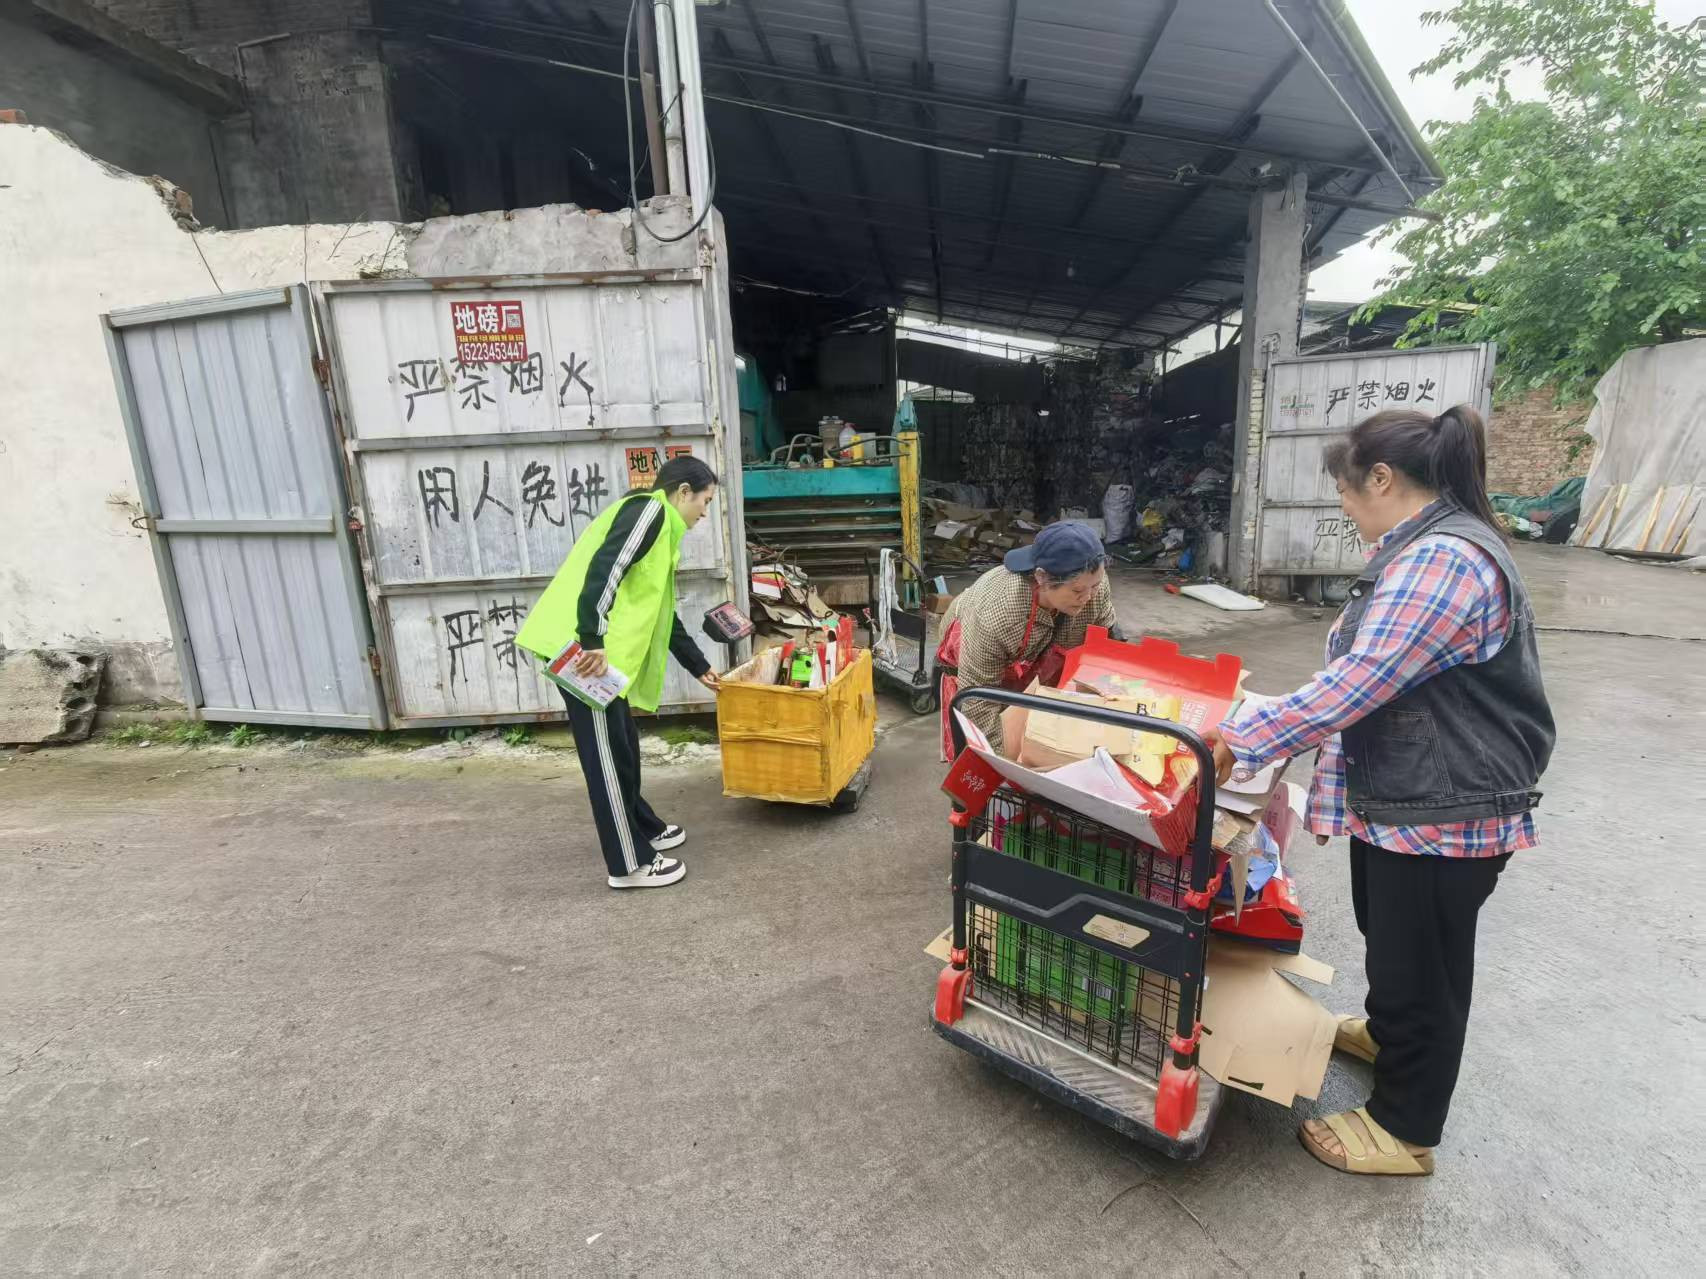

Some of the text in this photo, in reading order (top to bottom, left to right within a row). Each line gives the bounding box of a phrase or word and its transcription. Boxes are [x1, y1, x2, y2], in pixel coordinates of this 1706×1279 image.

[454, 304, 520, 334] 地磅厂
[459, 342, 525, 361] 15223453447
[398, 351, 595, 423] 严禁烟火
[1326, 378, 1436, 422] 严禁烟火
[418, 460, 609, 531] 闲人免进
